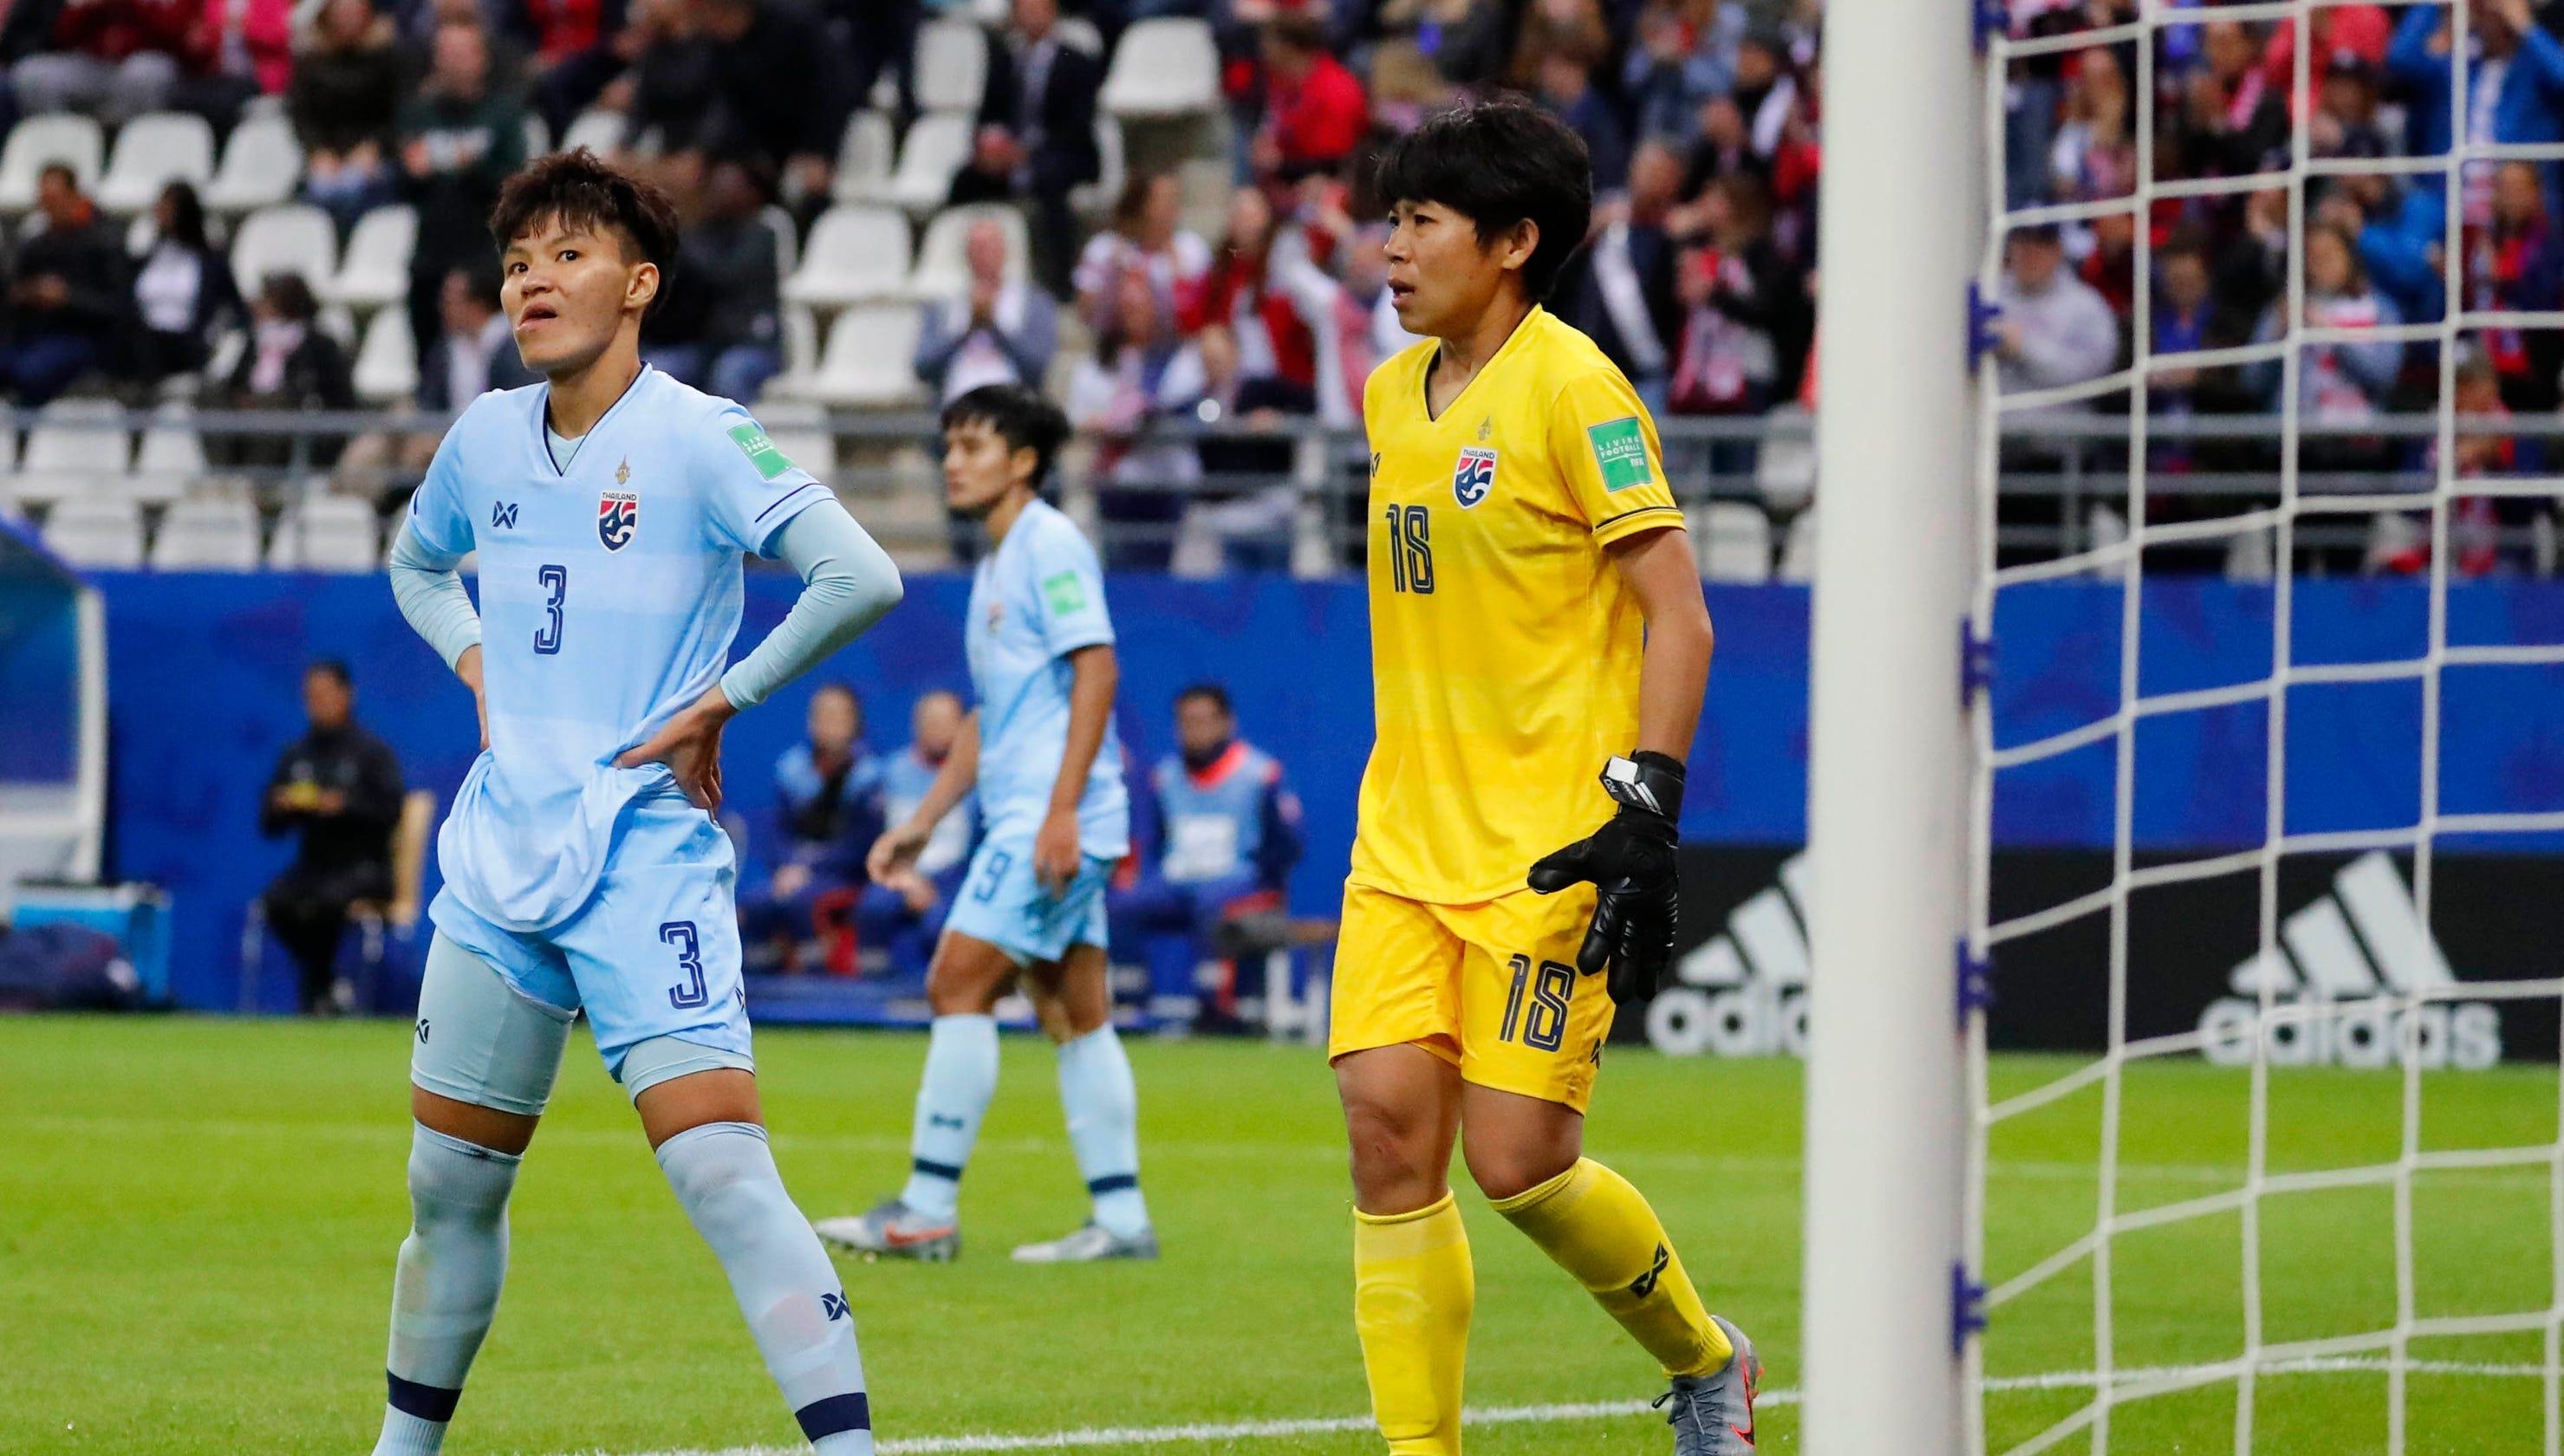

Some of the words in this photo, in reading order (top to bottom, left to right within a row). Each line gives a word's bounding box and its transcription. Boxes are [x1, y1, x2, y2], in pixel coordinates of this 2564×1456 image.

[602, 491, 637, 501] THAILAND
[1463, 449, 1494, 459] THAILAND
[1385, 503, 1435, 595] 18
[533, 563, 567, 655] 3
[973, 851, 1012, 904] 9
[659, 920, 709, 1011] 3
[1499, 952, 1577, 1053] 18
